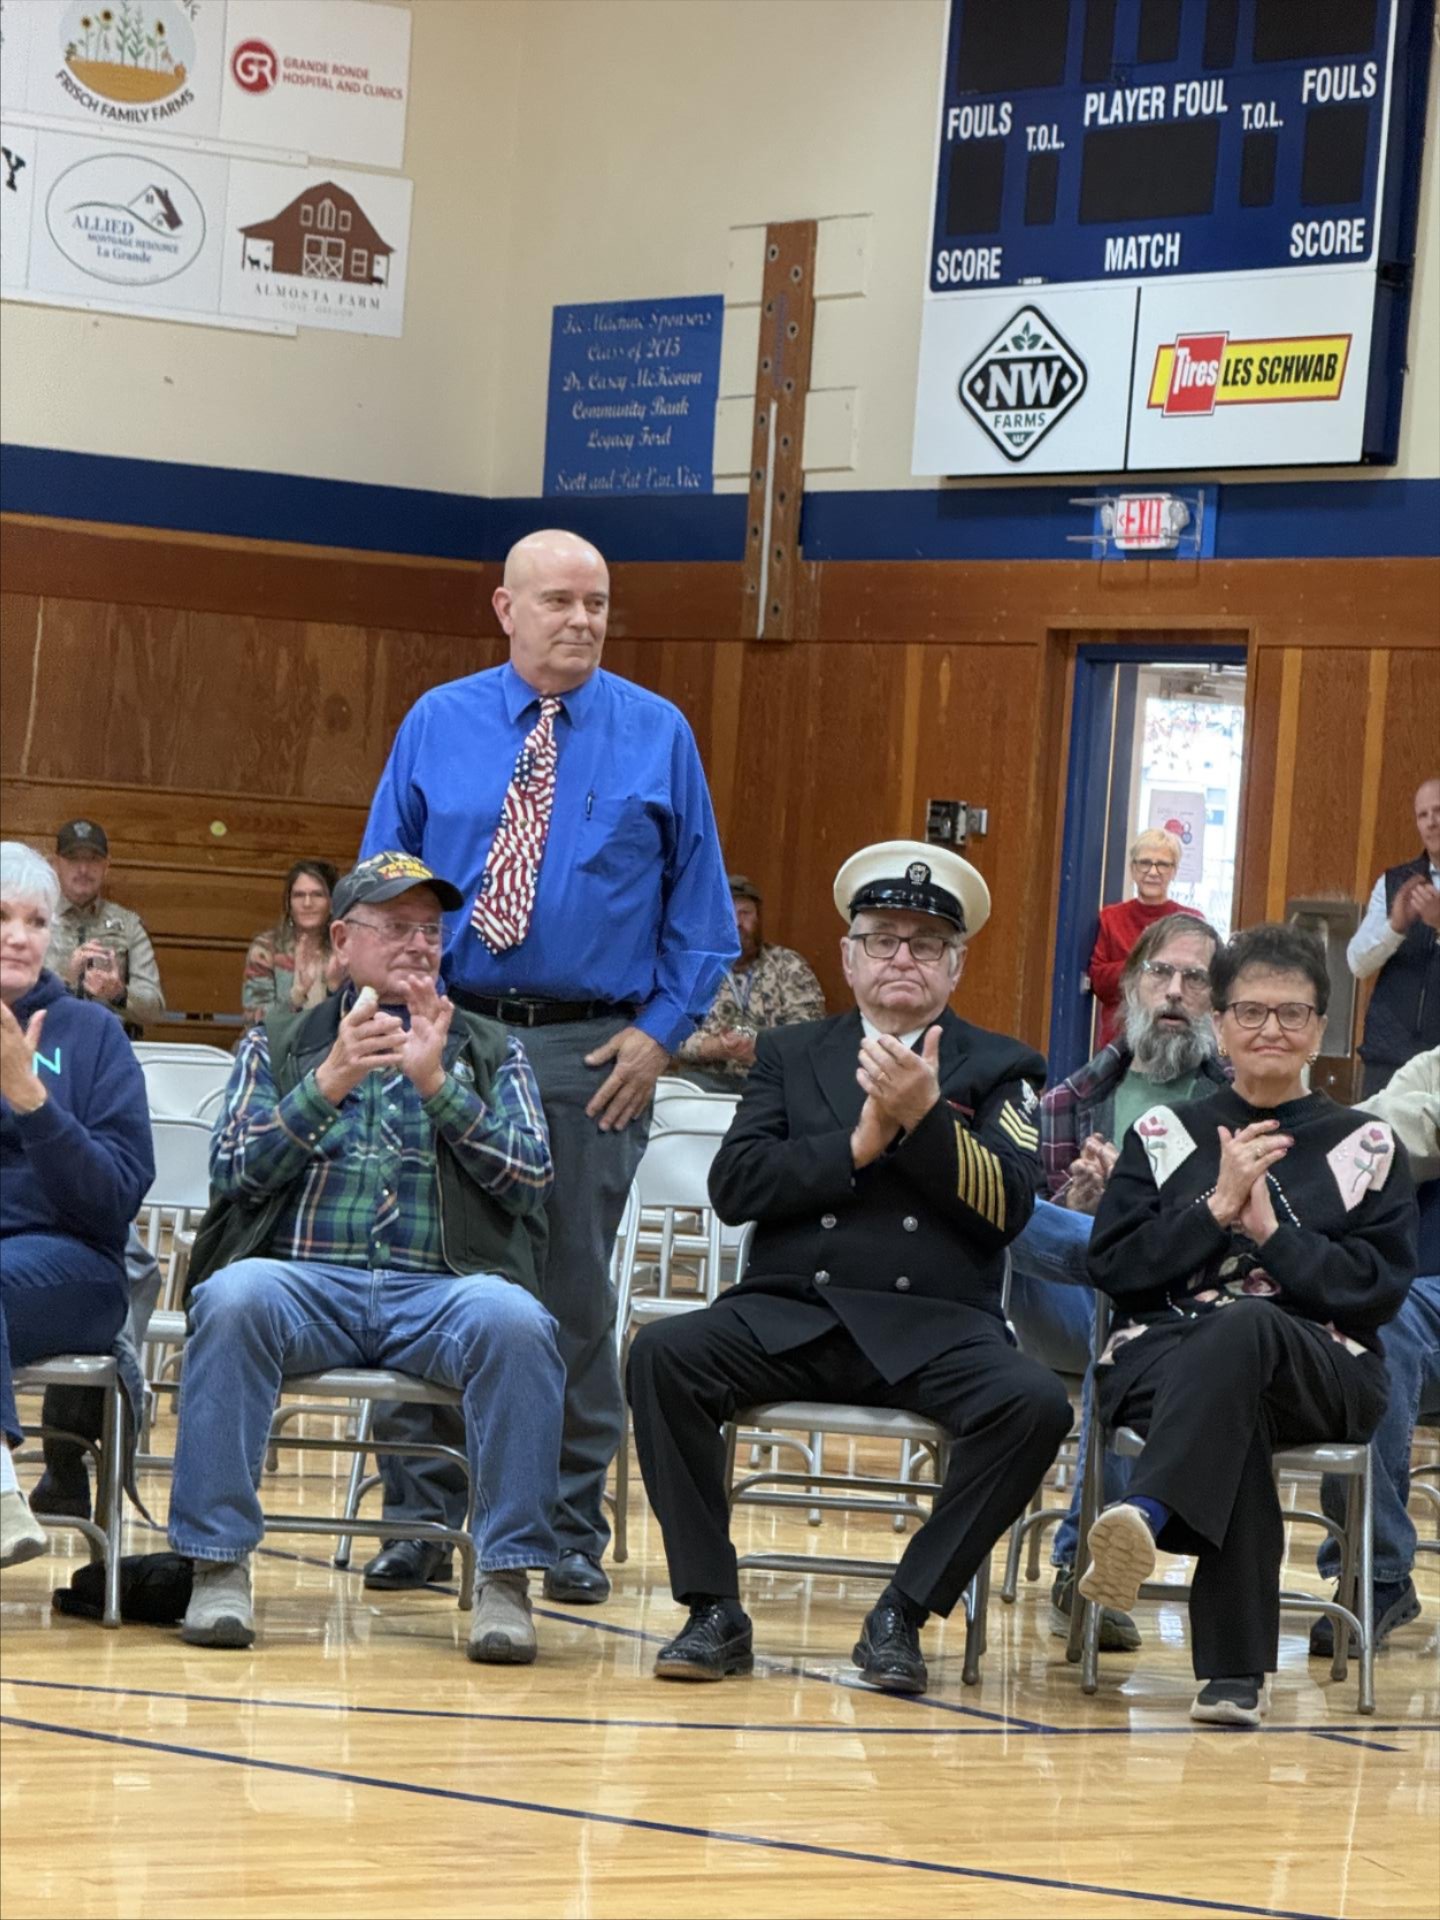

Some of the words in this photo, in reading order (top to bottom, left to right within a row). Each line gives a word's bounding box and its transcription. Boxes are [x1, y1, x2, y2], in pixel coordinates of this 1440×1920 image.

[236, 51, 275, 85] GR
[283, 57, 328, 75] GRANDE
[331, 63, 369, 80] RONDE
[56, 69, 99, 112] FRISCH
[100, 103, 149, 123] FAMILY
[151, 89, 195, 121] FARMS
[282, 72, 333, 90] HOSPITAL
[335, 80, 361, 94] AND
[363, 83, 403, 100] CLINICS
[1302, 62, 1378, 104] FOULS
[1083, 84, 1166, 127] PLAYER
[1172, 79, 1228, 118] FOUL
[1241, 100, 1283, 131] T.O.L.
[946, 101, 1012, 141] FOULS
[1026, 124, 1065, 152] T.O.L.
[72, 214, 135, 237] ALLIED
[1289, 218, 1365, 258] SCORE
[97, 245, 110, 258] La
[112, 248, 151, 263] Grande
[936, 247, 1002, 284] SCORE
[1105, 233, 1180, 272] MATCH
[255, 283, 329, 304] ALMOSTA
[338, 293, 381, 310] FARM
[587, 344, 624, 361] Class
[627, 343, 642, 363] of
[646, 337, 681, 359] 2015
[562, 371, 584, 391] Dr.
[986, 360, 1063, 408] NW
[1171, 347, 1219, 396] Tires
[1222, 357, 1254, 387] LES
[1255, 352, 1340, 386] SCHWAB
[572, 400, 647, 420] Community
[650, 395, 690, 416] Bank
[994, 412, 1046, 429] FARMS
[586, 429, 635, 451] Legacy
[638, 426, 672, 447] Ford
[1011, 433, 1026, 444] LLC
[590, 469, 615, 490] and
[1124, 498, 1164, 544] EXIT
